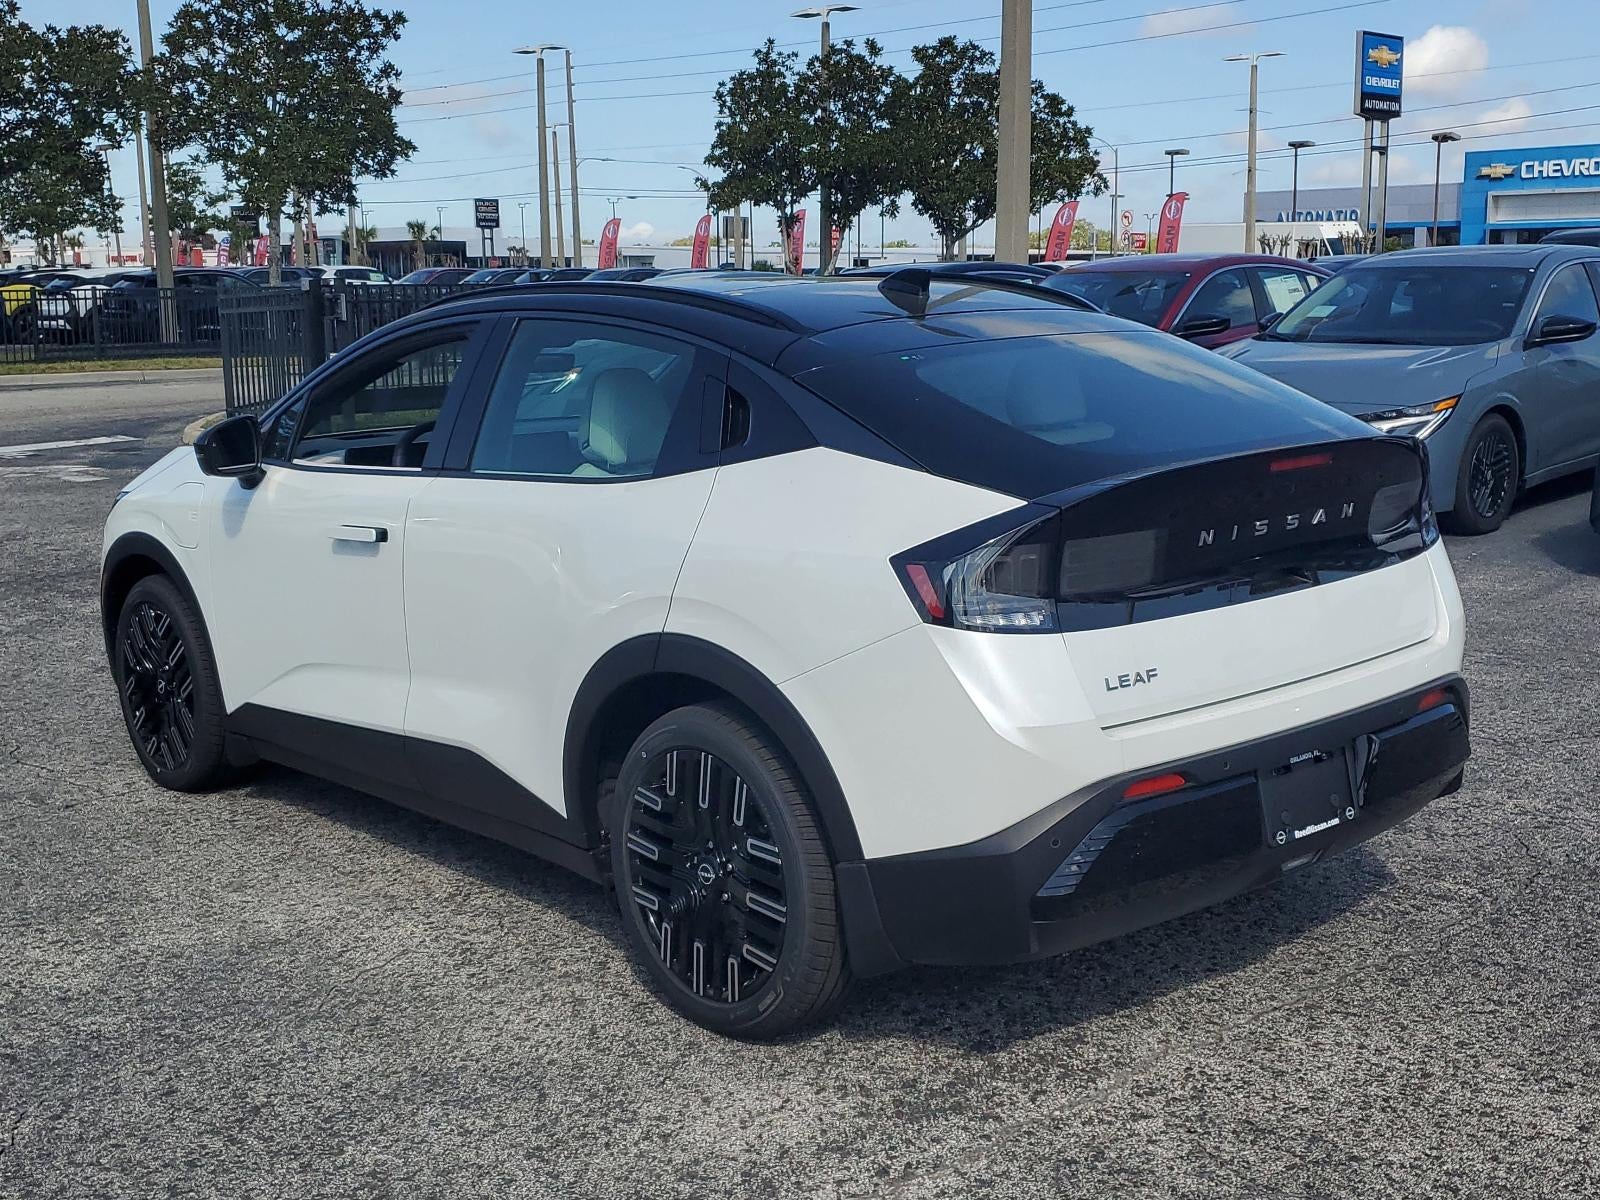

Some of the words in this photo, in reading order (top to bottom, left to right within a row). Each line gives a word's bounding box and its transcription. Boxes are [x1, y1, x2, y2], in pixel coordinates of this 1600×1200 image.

[1365, 75, 1401, 89] CHEVROLET
[1277, 209, 1359, 222] AUTONATIO
[1198, 502, 1354, 547] NISSAN
[1104, 667, 1158, 692] LEAF
